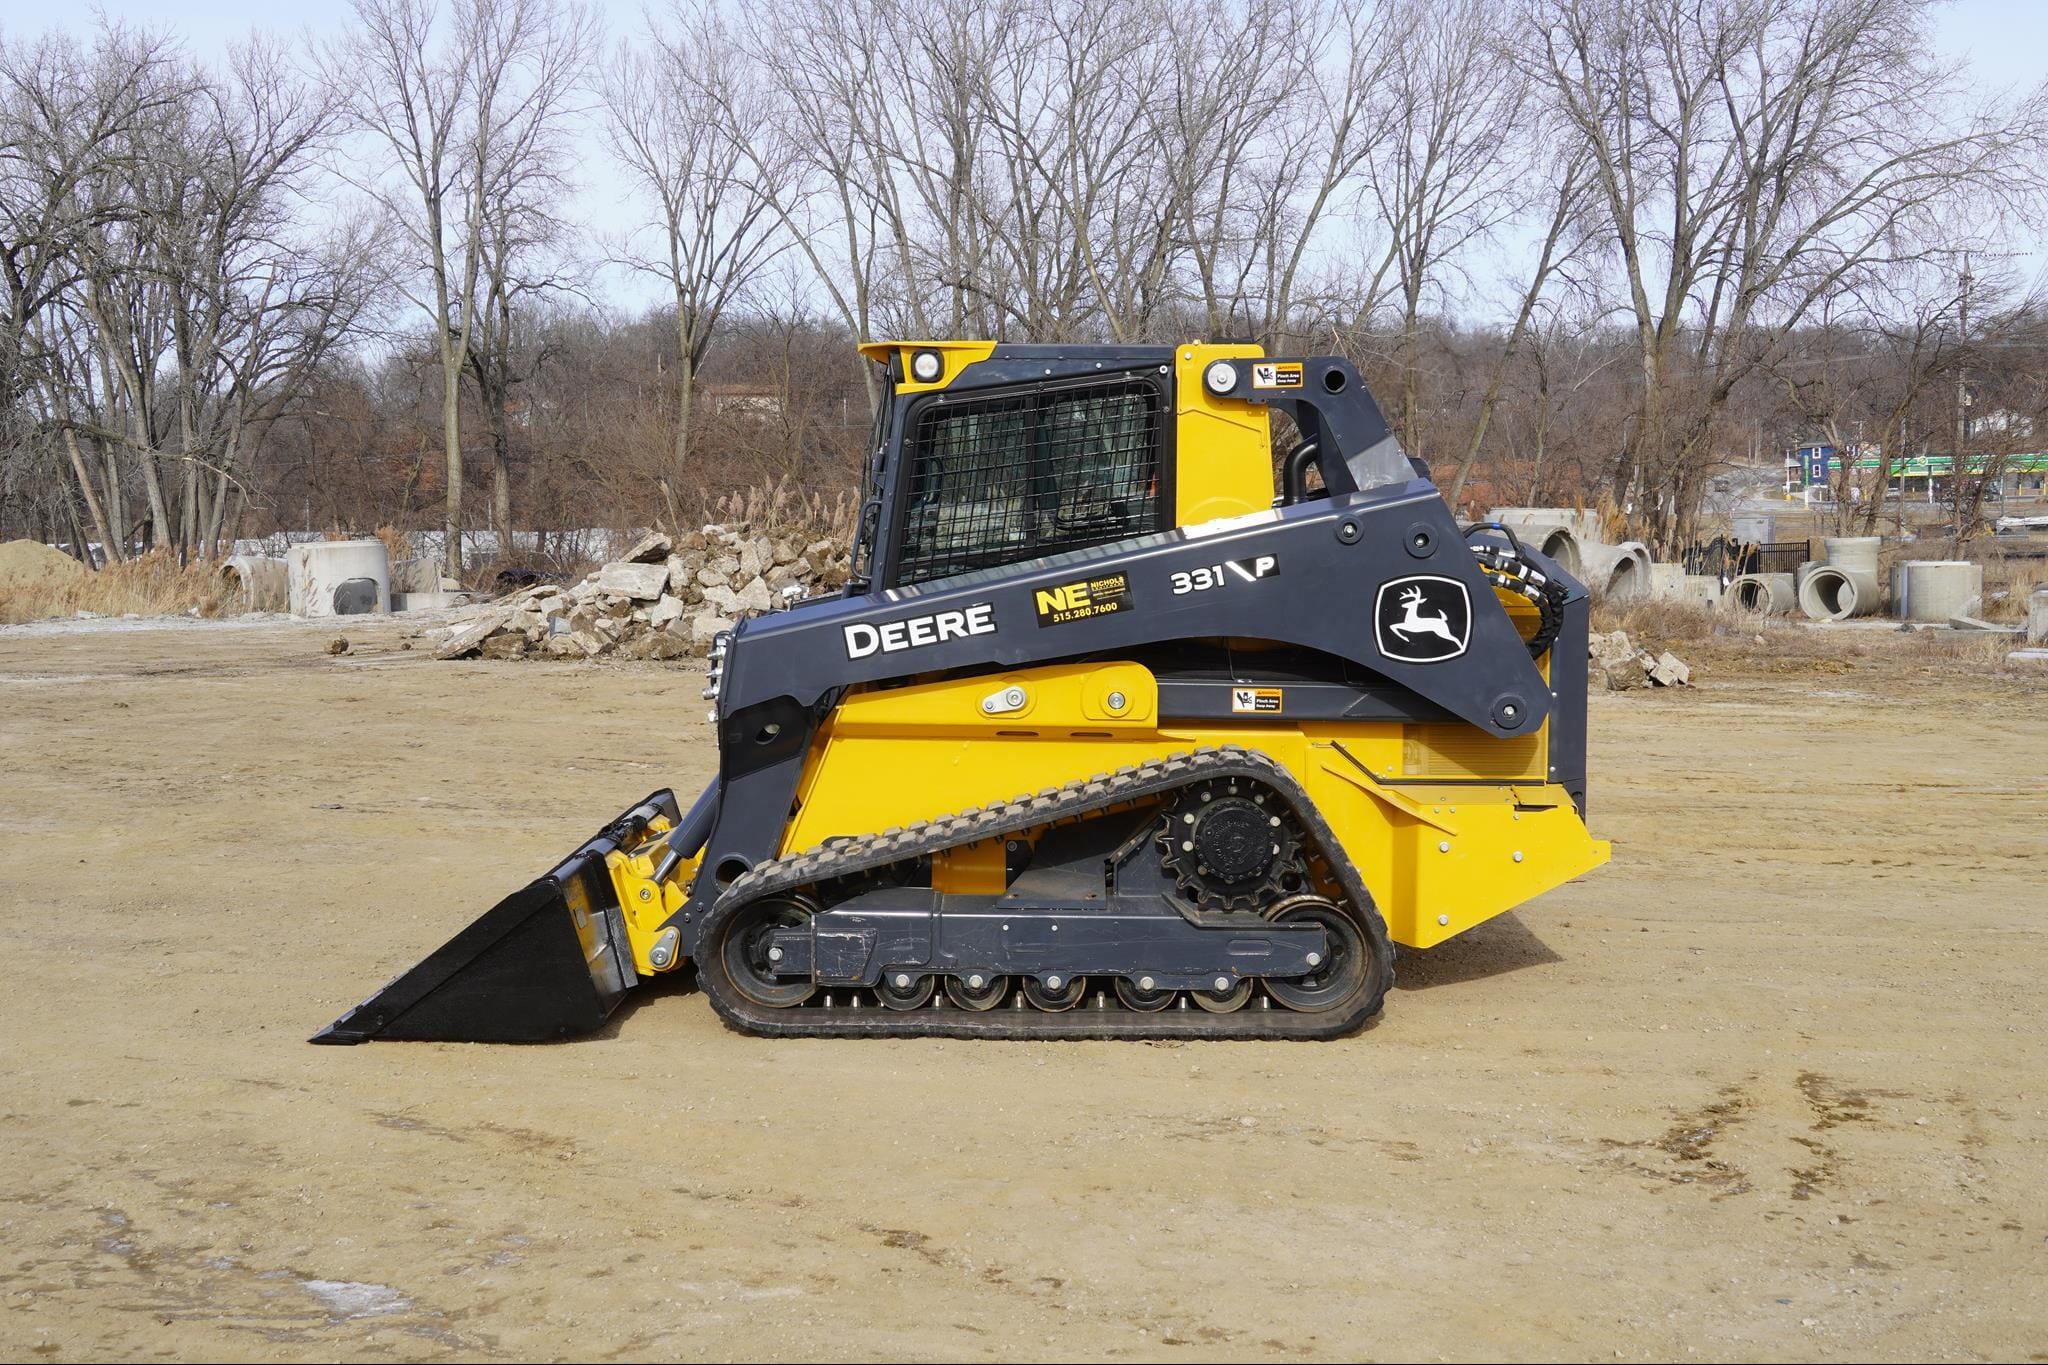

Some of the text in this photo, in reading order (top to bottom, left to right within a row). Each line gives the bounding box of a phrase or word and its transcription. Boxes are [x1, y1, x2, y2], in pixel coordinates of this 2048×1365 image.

[1090, 576, 1125, 589] NICHOLS
[1170, 564, 1225, 595] 331
[1036, 582, 1091, 615] NE
[1053, 602, 1118, 623] 515.280.7600
[844, 604, 996, 659] DEERE
